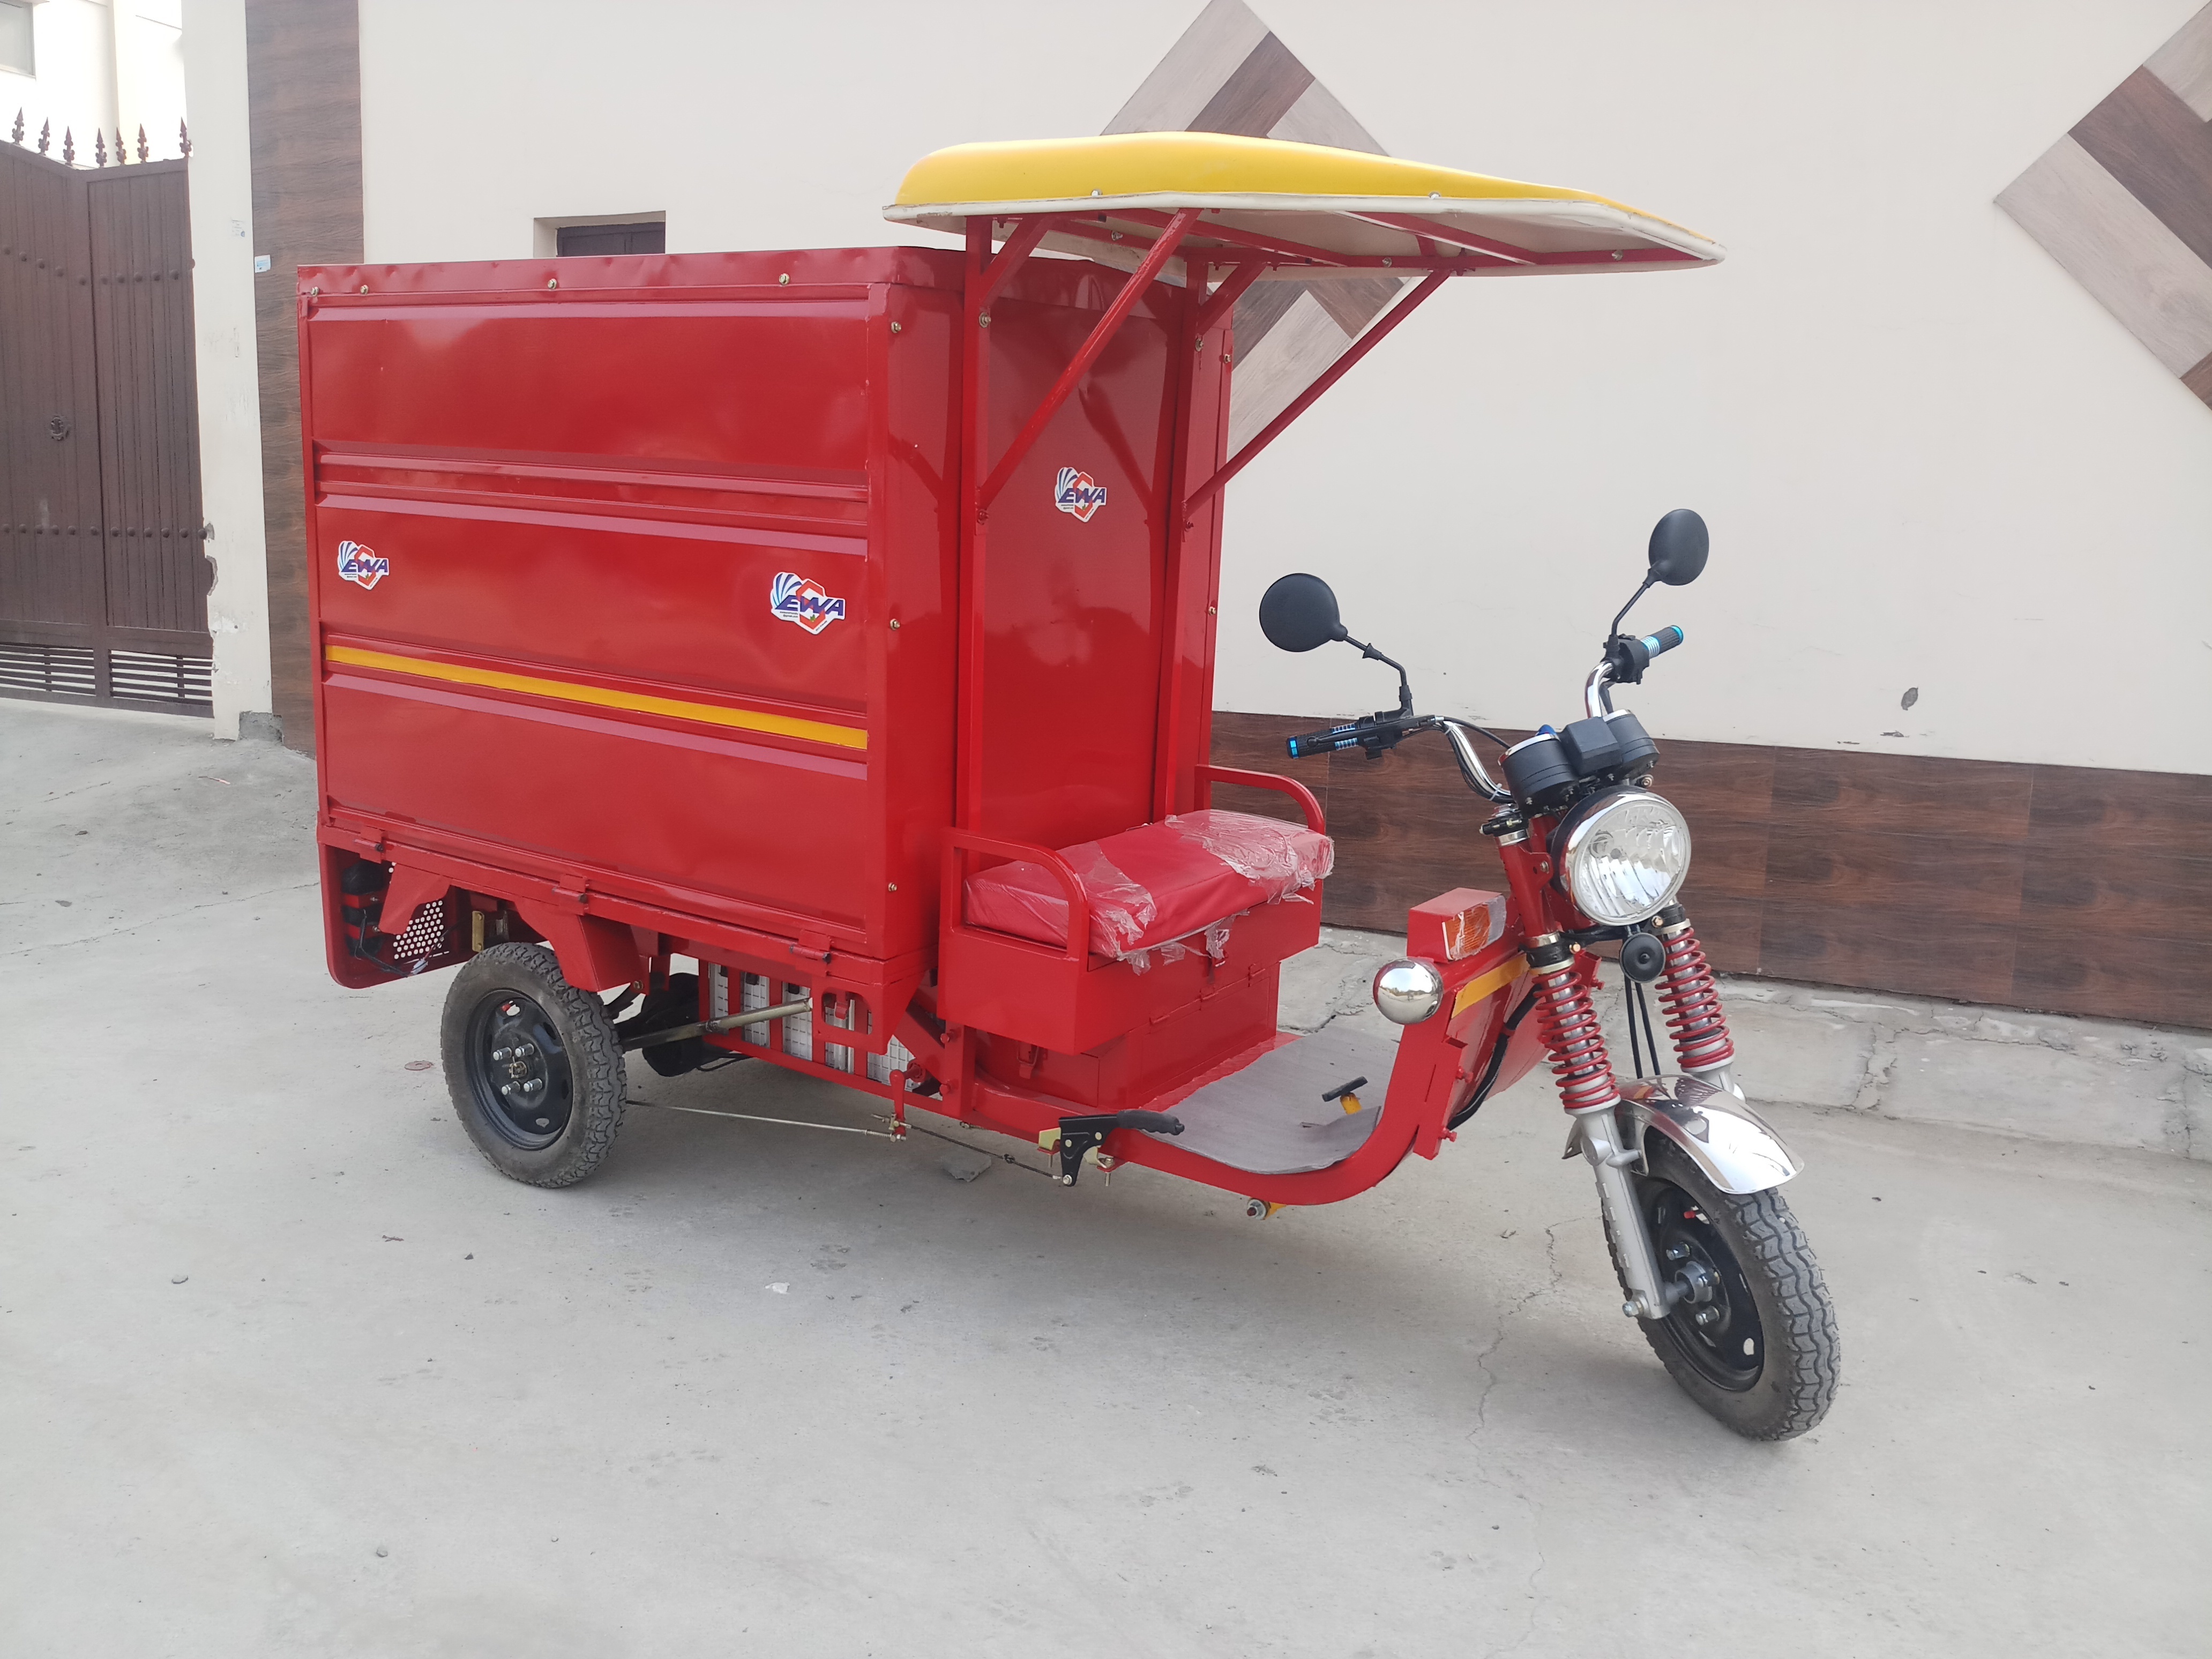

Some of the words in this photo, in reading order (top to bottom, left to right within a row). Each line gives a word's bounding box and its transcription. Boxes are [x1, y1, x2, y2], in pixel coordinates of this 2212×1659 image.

[1058, 488, 1106, 503] EWA
[341, 559, 388, 573] EWA
[774, 594, 844, 616] EWA
